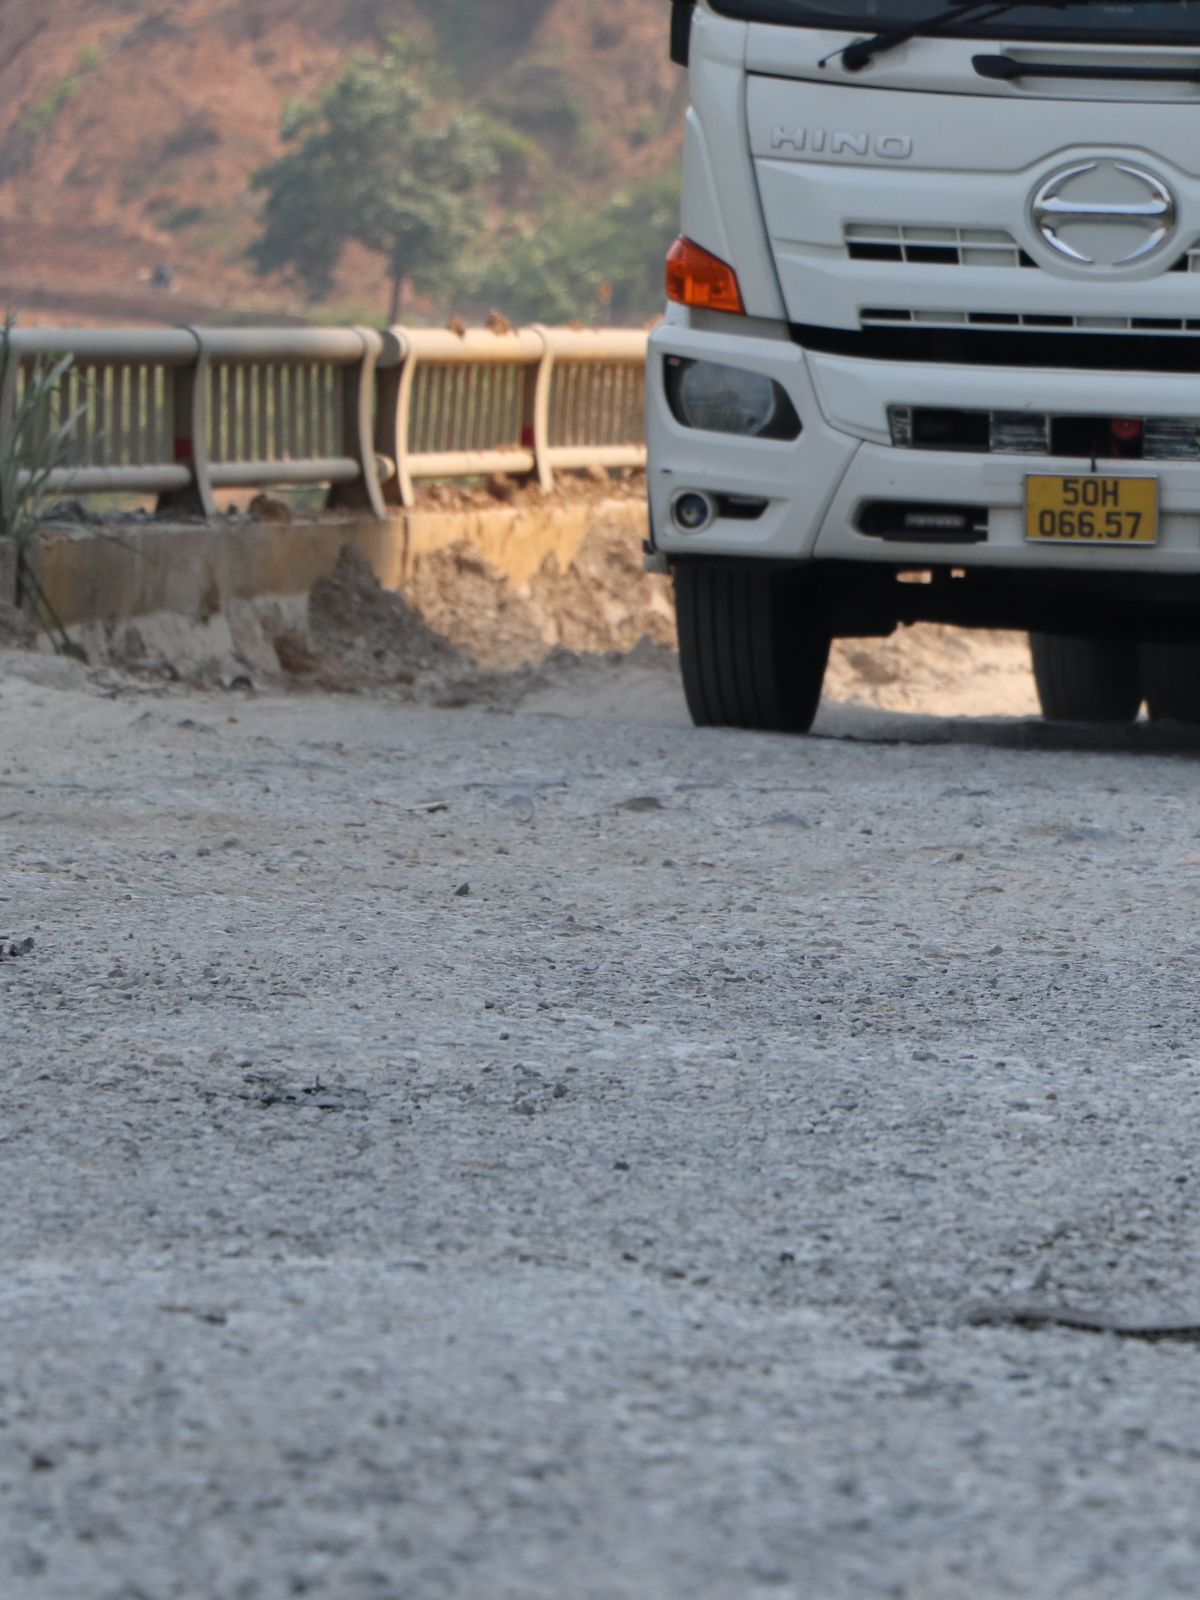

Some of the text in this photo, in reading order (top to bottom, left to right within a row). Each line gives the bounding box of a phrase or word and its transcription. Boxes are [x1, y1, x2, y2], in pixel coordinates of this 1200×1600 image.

[770, 126, 913, 159] HINO
[1062, 478, 1119, 506] 50H
[1039, 509, 1142, 538] 066.57
